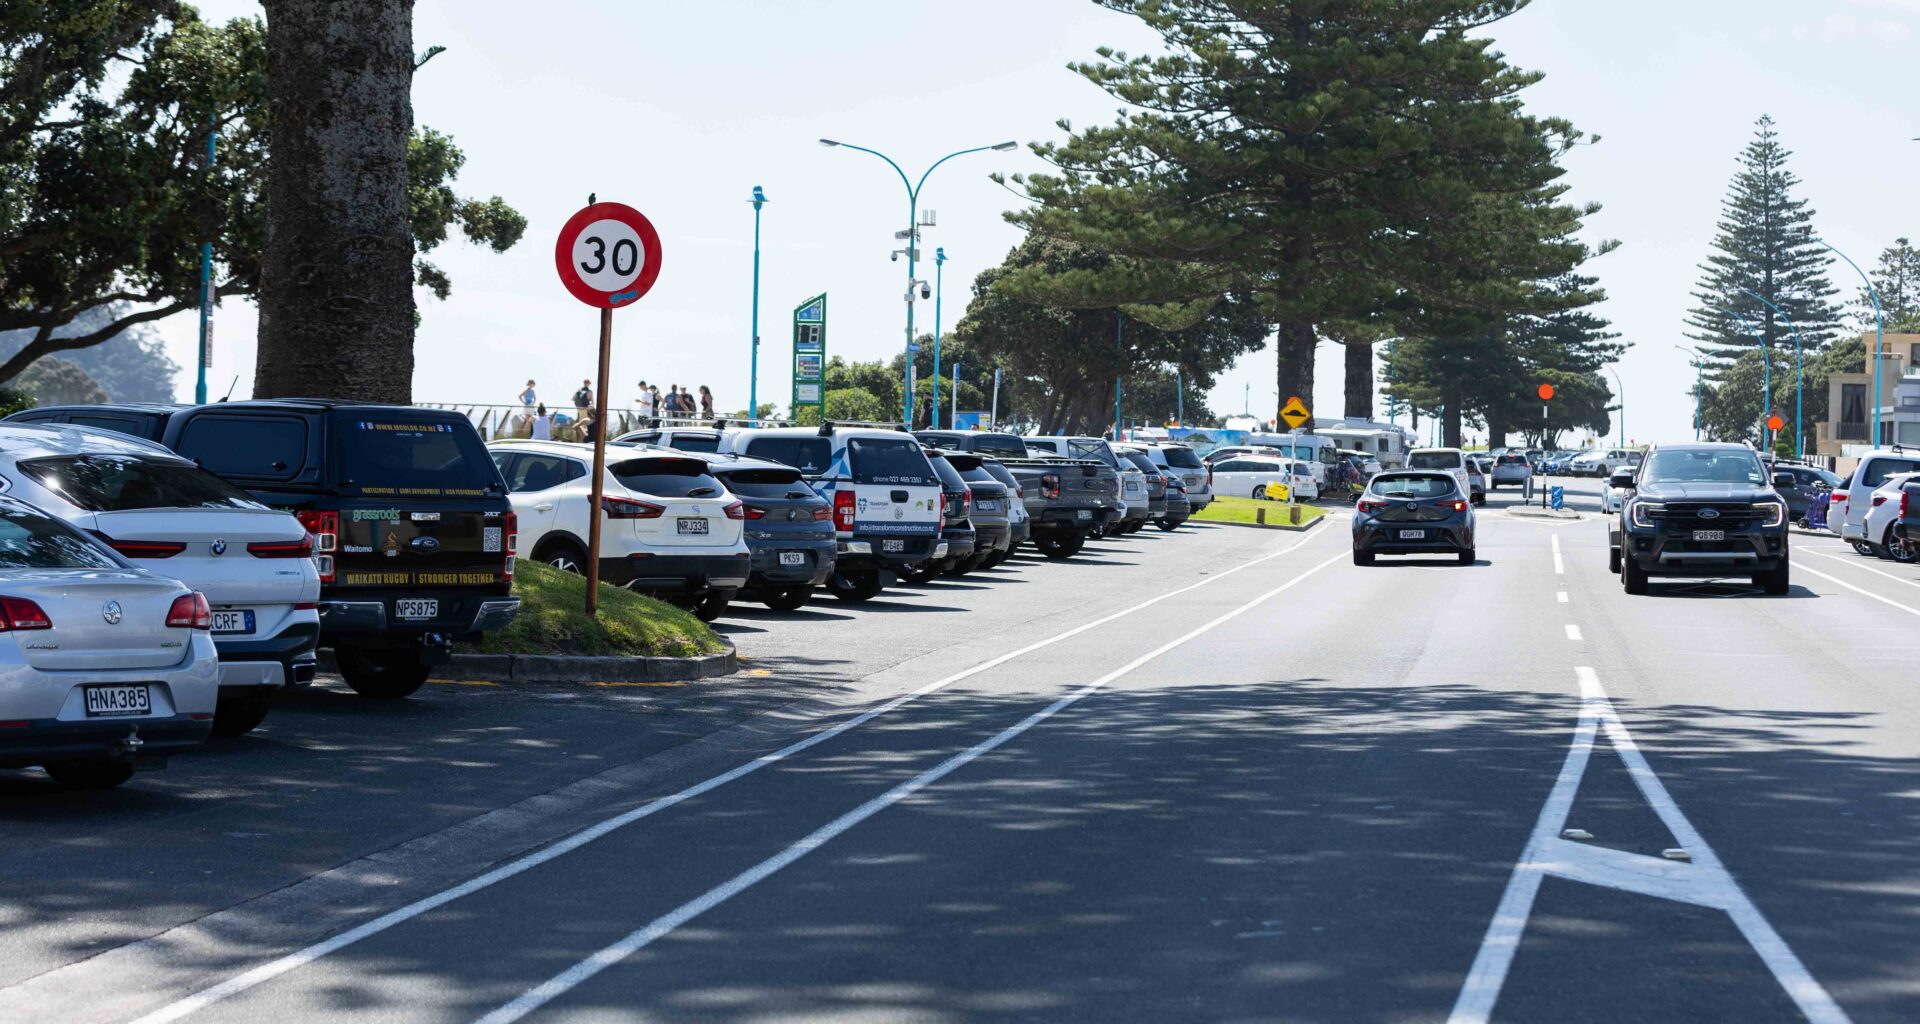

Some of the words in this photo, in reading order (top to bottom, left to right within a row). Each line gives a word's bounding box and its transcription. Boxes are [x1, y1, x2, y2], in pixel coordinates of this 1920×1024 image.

[581, 236, 638, 276] 30
[353, 507, 401, 523] grassroots
[679, 521, 707, 531] NRJ334
[344, 544, 373, 553] Waitomo
[784, 553, 800, 563] PKS9
[346, 573, 383, 585] WAIKATO
[383, 573, 409, 585] RUGBY
[419, 573, 458, 584] STRONGER
[458, 573, 494, 584] TOGETHER
[396, 601, 437, 616] NPS875
[89, 689, 148, 710] HNA385
